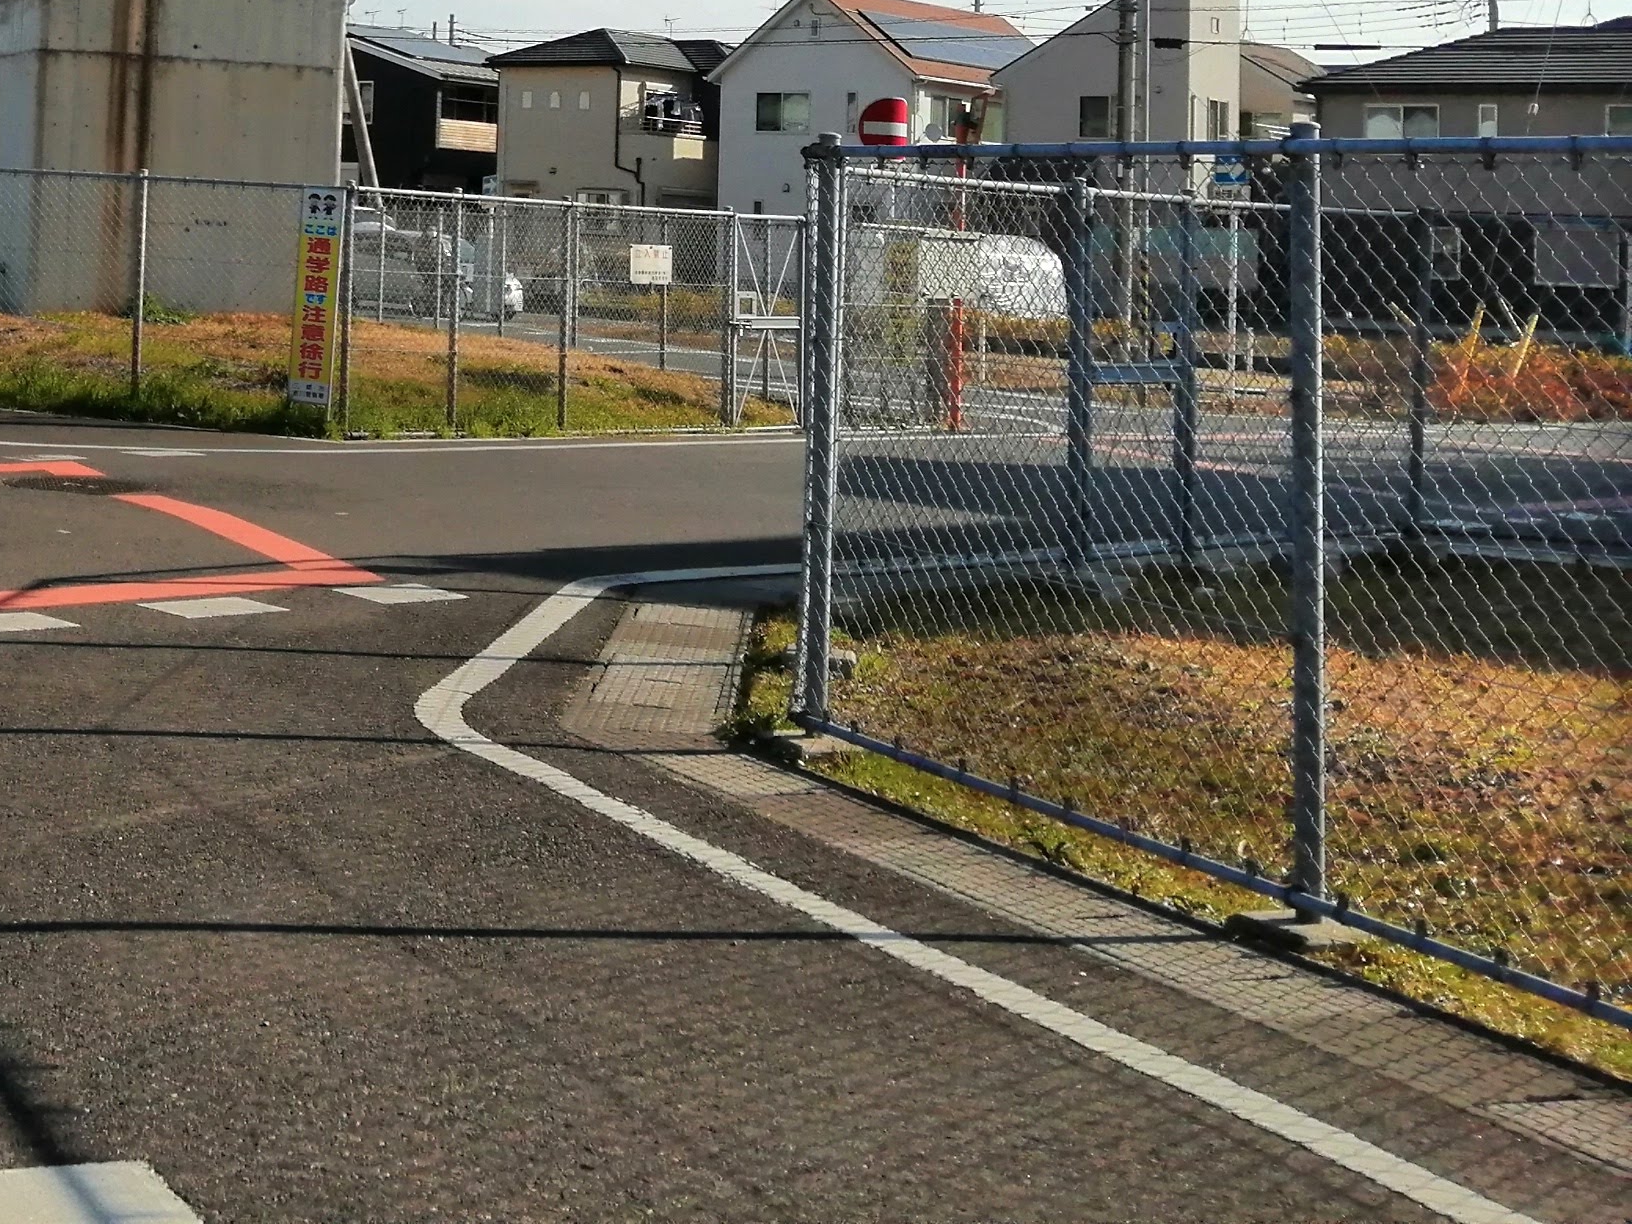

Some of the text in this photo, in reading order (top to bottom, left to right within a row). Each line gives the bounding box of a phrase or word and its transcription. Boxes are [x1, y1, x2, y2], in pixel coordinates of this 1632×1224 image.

[304, 225, 338, 237] ここは
[303, 237, 331, 293] 通学路
[305, 294, 327, 305] です
[298, 305, 327, 381] 注意徐行
